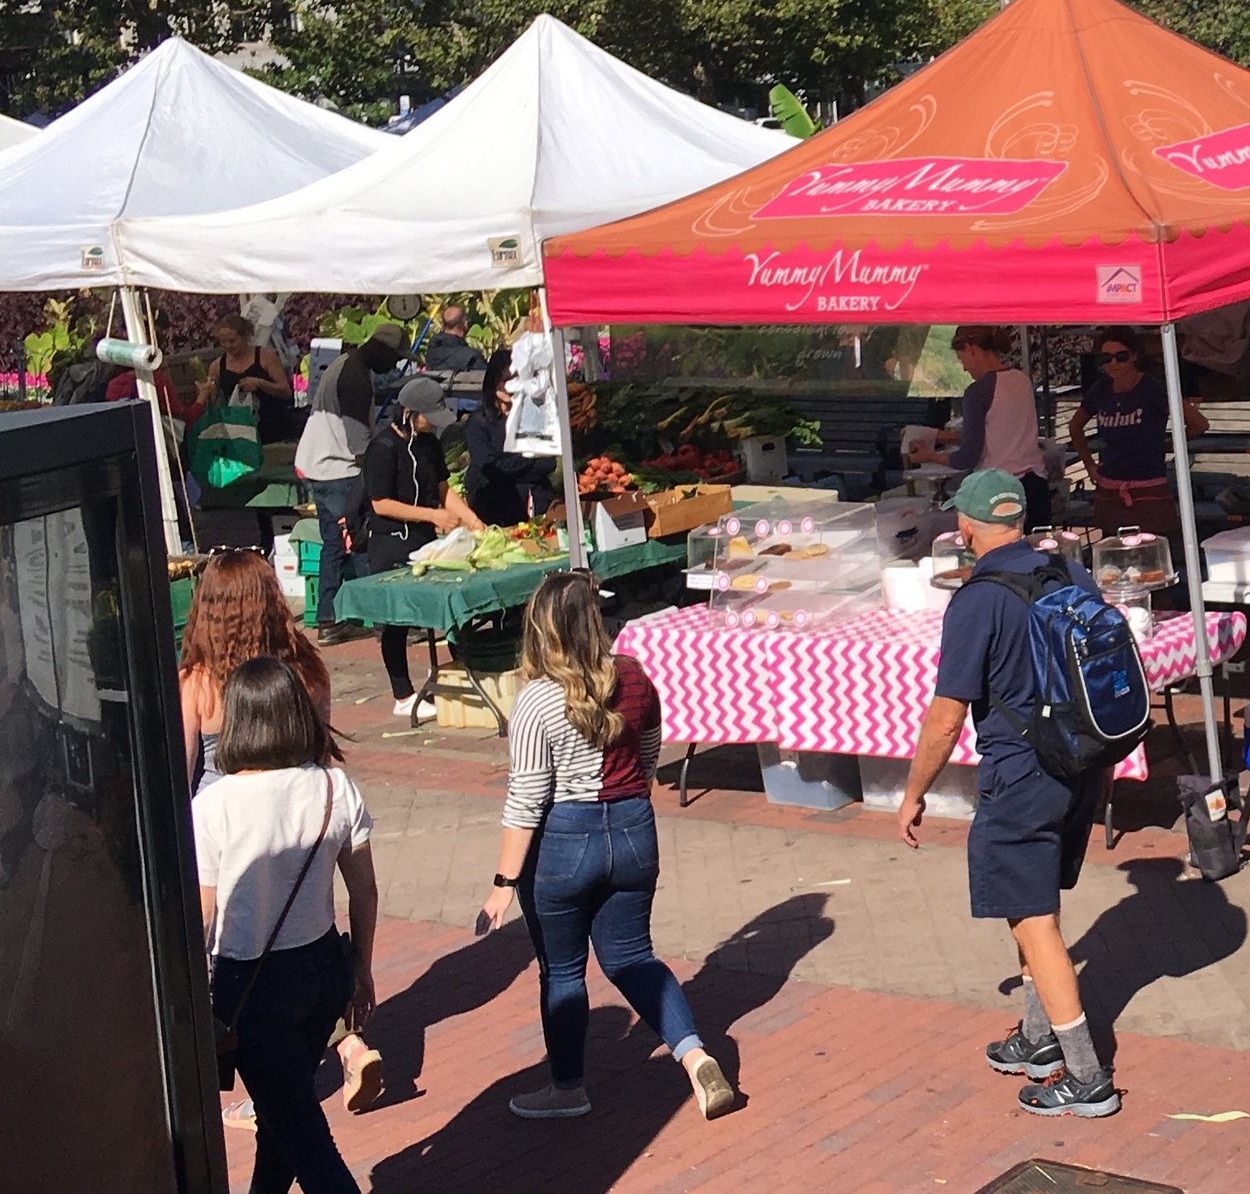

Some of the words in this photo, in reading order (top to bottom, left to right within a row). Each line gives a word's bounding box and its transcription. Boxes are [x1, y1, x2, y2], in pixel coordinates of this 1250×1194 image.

[787, 168, 899, 212] Yummy
[860, 198, 957, 211] BAKERY
[744, 251, 822, 311] Yummy
[820, 249, 922, 310] Mummy
[817, 296, 881, 311] BAKERY
